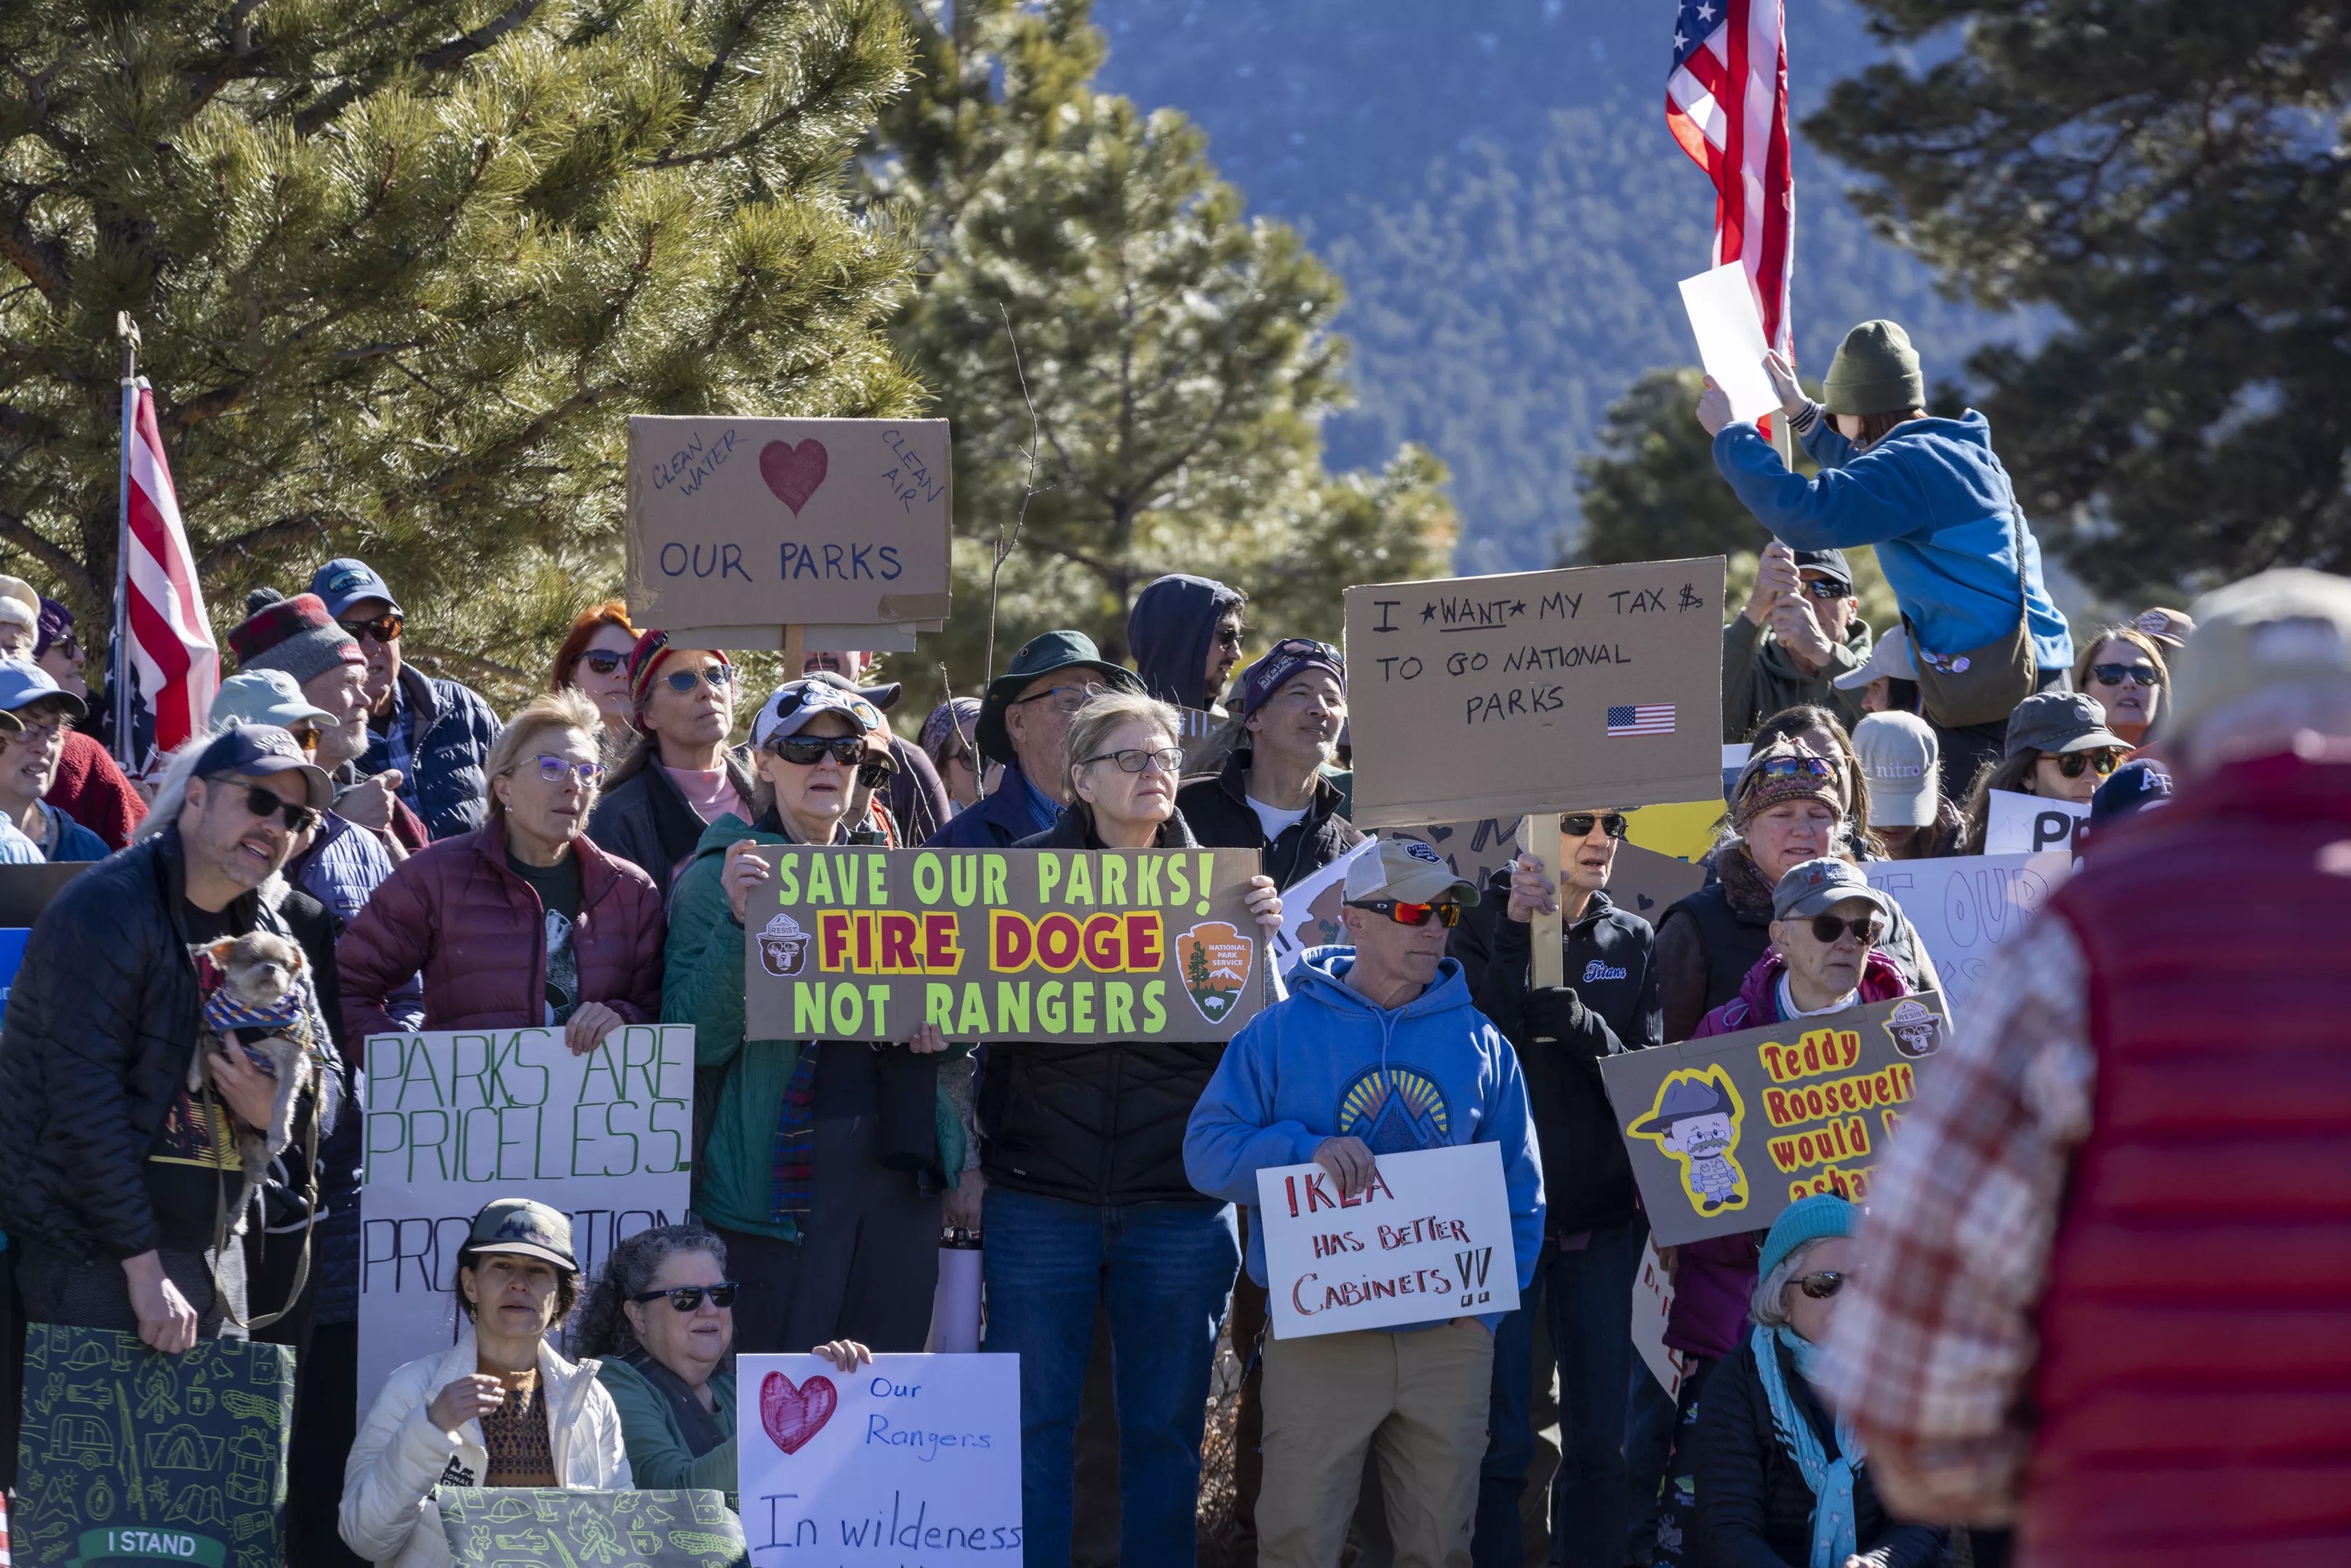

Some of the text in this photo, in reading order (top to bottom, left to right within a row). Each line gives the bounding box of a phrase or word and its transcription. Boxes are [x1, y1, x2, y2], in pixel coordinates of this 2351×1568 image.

[653, 431, 704, 491] CLEAN
[680, 428, 749, 497] WATER
[881, 429, 945, 503] CLEAN
[881, 467, 918, 514] AIR
[660, 542, 902, 582] OUR PARKS
[1372, 600, 1401, 633] I
[1539, 592, 1584, 619] MY
[1608, 587, 1667, 616] TAX
[1376, 643, 1632, 682] TO GO NATIONAL
[1467, 685, 1565, 724] PARKS
[1875, 760, 1921, 778] nitro
[779, 852, 1215, 917] SAVE OUR PARKS!
[818, 910, 963, 975] FIRE
[992, 910, 1163, 973] DOGE
[1582, 959, 1627, 983] Titans
[794, 980, 1166, 1037] NOT RANGERS
[1899, 1010, 1926, 1021] RESIST
[368, 1026, 692, 1110] PARKS ARE
[1764, 1032, 1857, 1081] Teddy
[1767, 1066, 1915, 1124] Roosevelt
[1772, 1119, 1867, 1169] would
[1312, 1215, 1472, 1259] HAS BETTER
[871, 1376, 923, 1398] Our
[865, 1413, 992, 1463] Rangers
[108, 1531, 197, 1558] I STAND
[754, 1490, 1022, 1552] In wildeness
